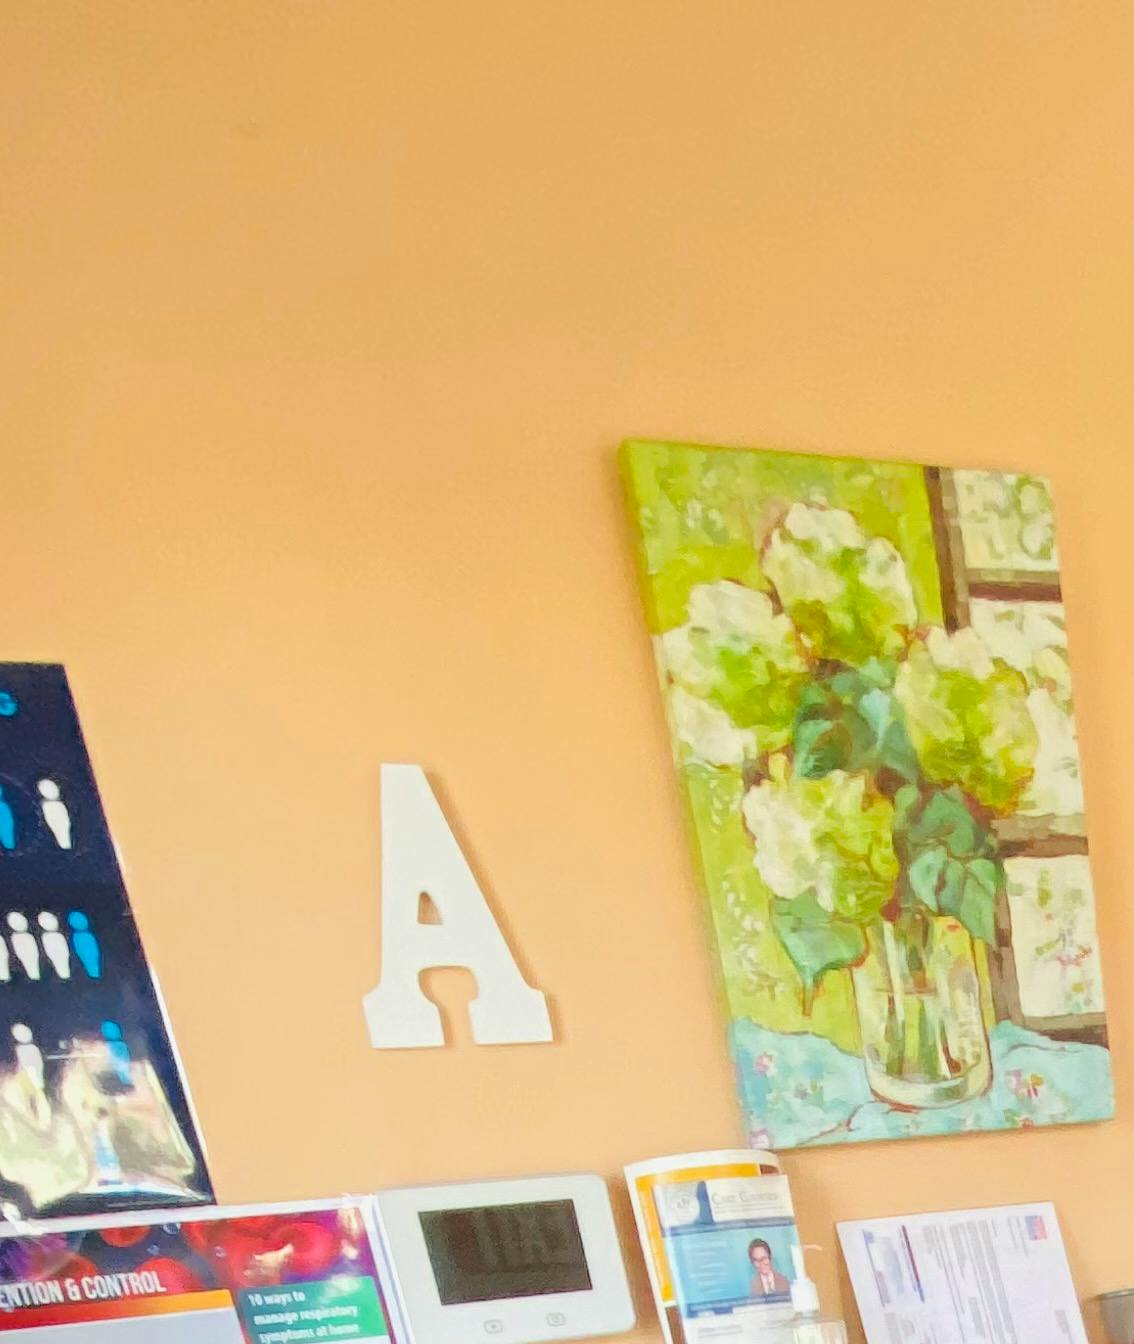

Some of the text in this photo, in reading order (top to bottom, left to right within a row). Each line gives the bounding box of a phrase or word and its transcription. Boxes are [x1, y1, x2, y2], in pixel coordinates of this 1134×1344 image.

[362, 763, 553, 1048] A
[64, 1279, 82, 1301] &
[82, 1270, 167, 1300] CONTROL
[248, 1293, 263, 1307] 10
[292, 1291, 306, 1303] to
[253, 1306, 358, 1326] manage respiratory
[258, 1329, 316, 1344] symptoms
[328, 1324, 360, 1336] home
